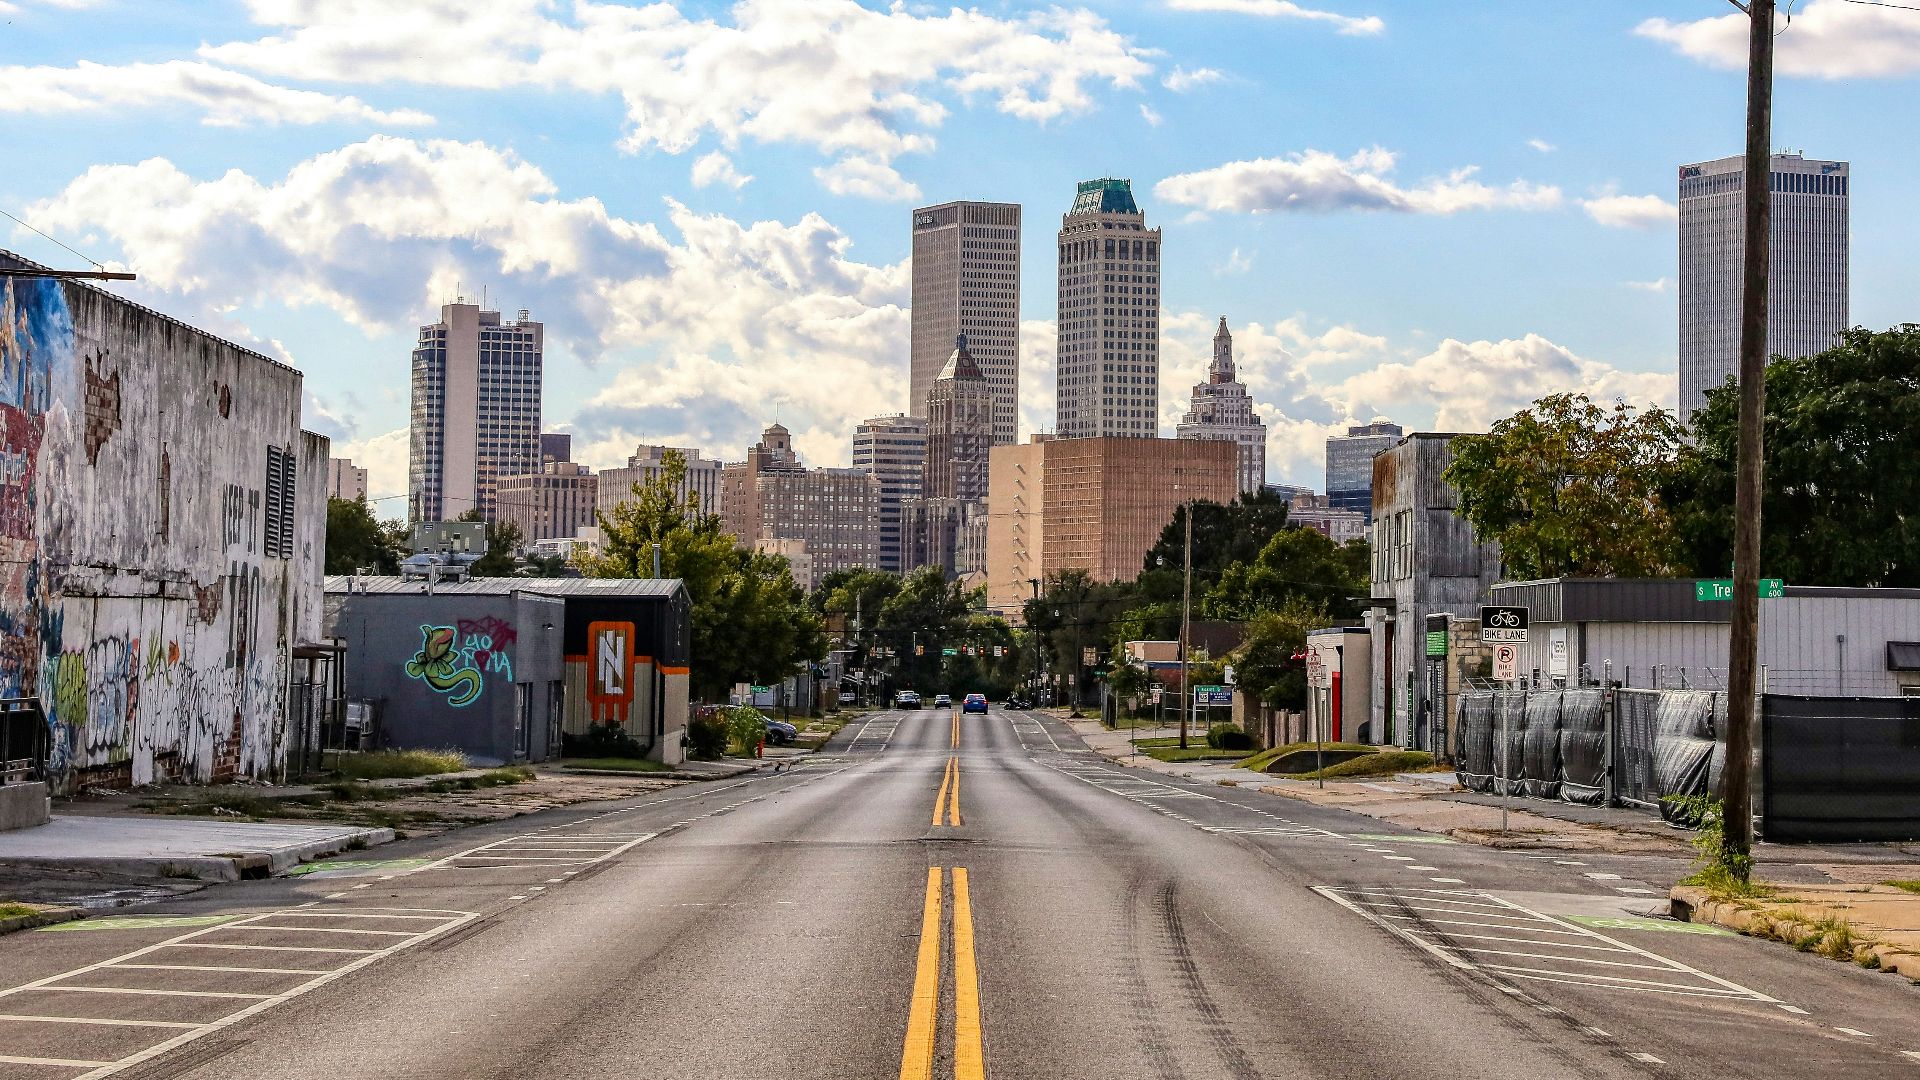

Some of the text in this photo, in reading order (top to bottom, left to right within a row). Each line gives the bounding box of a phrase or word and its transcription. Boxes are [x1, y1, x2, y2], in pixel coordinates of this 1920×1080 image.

[222, 482, 260, 555] KEEP IT
[1697, 580, 1779, 598] S Tre Av
[1768, 589, 1782, 597] 600
[1484, 629, 1526, 640] BIKE LANE
